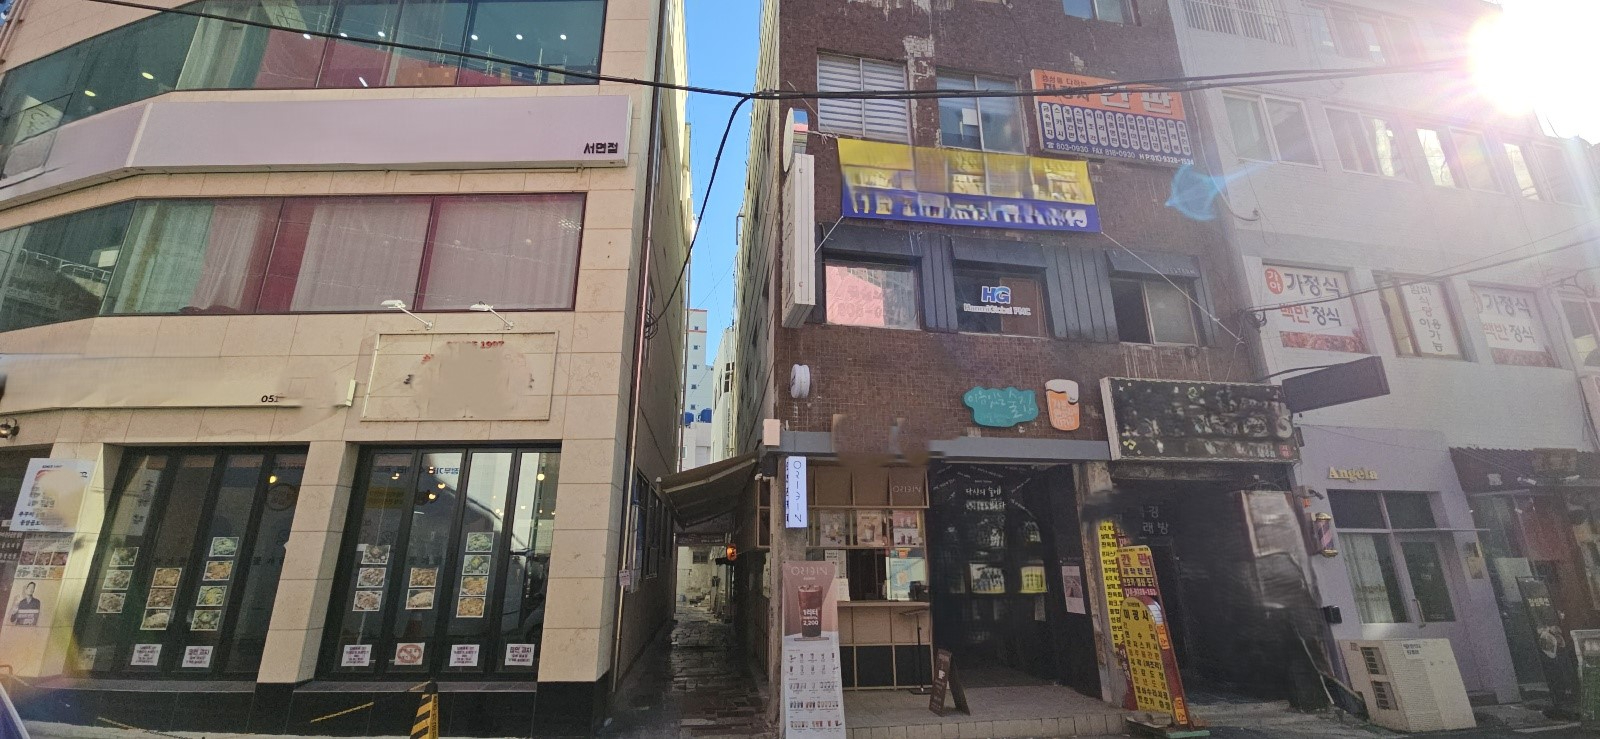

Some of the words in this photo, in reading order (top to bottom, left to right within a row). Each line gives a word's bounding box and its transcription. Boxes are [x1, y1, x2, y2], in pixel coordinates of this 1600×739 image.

[1055, 108, 1064, 137] 스카시
[1097, 113, 1107, 143] 대리석
[583, 142, 618, 154] 서면점
[1092, 147, 1103, 155] FAX
[981, 285, 1011, 304] HG
[1283, 272, 1341, 298] 가정식
[1280, 303, 1310, 324] 백반
[1311, 306, 1341, 326] 정식
[1482, 293, 1533, 319] 가정식
[1509, 324, 1535, 343] 정식
[1328, 466, 1379, 483] Angela
[803, 608, 819, 617] 1리터
[1123, 609, 1149, 621] 미광사
